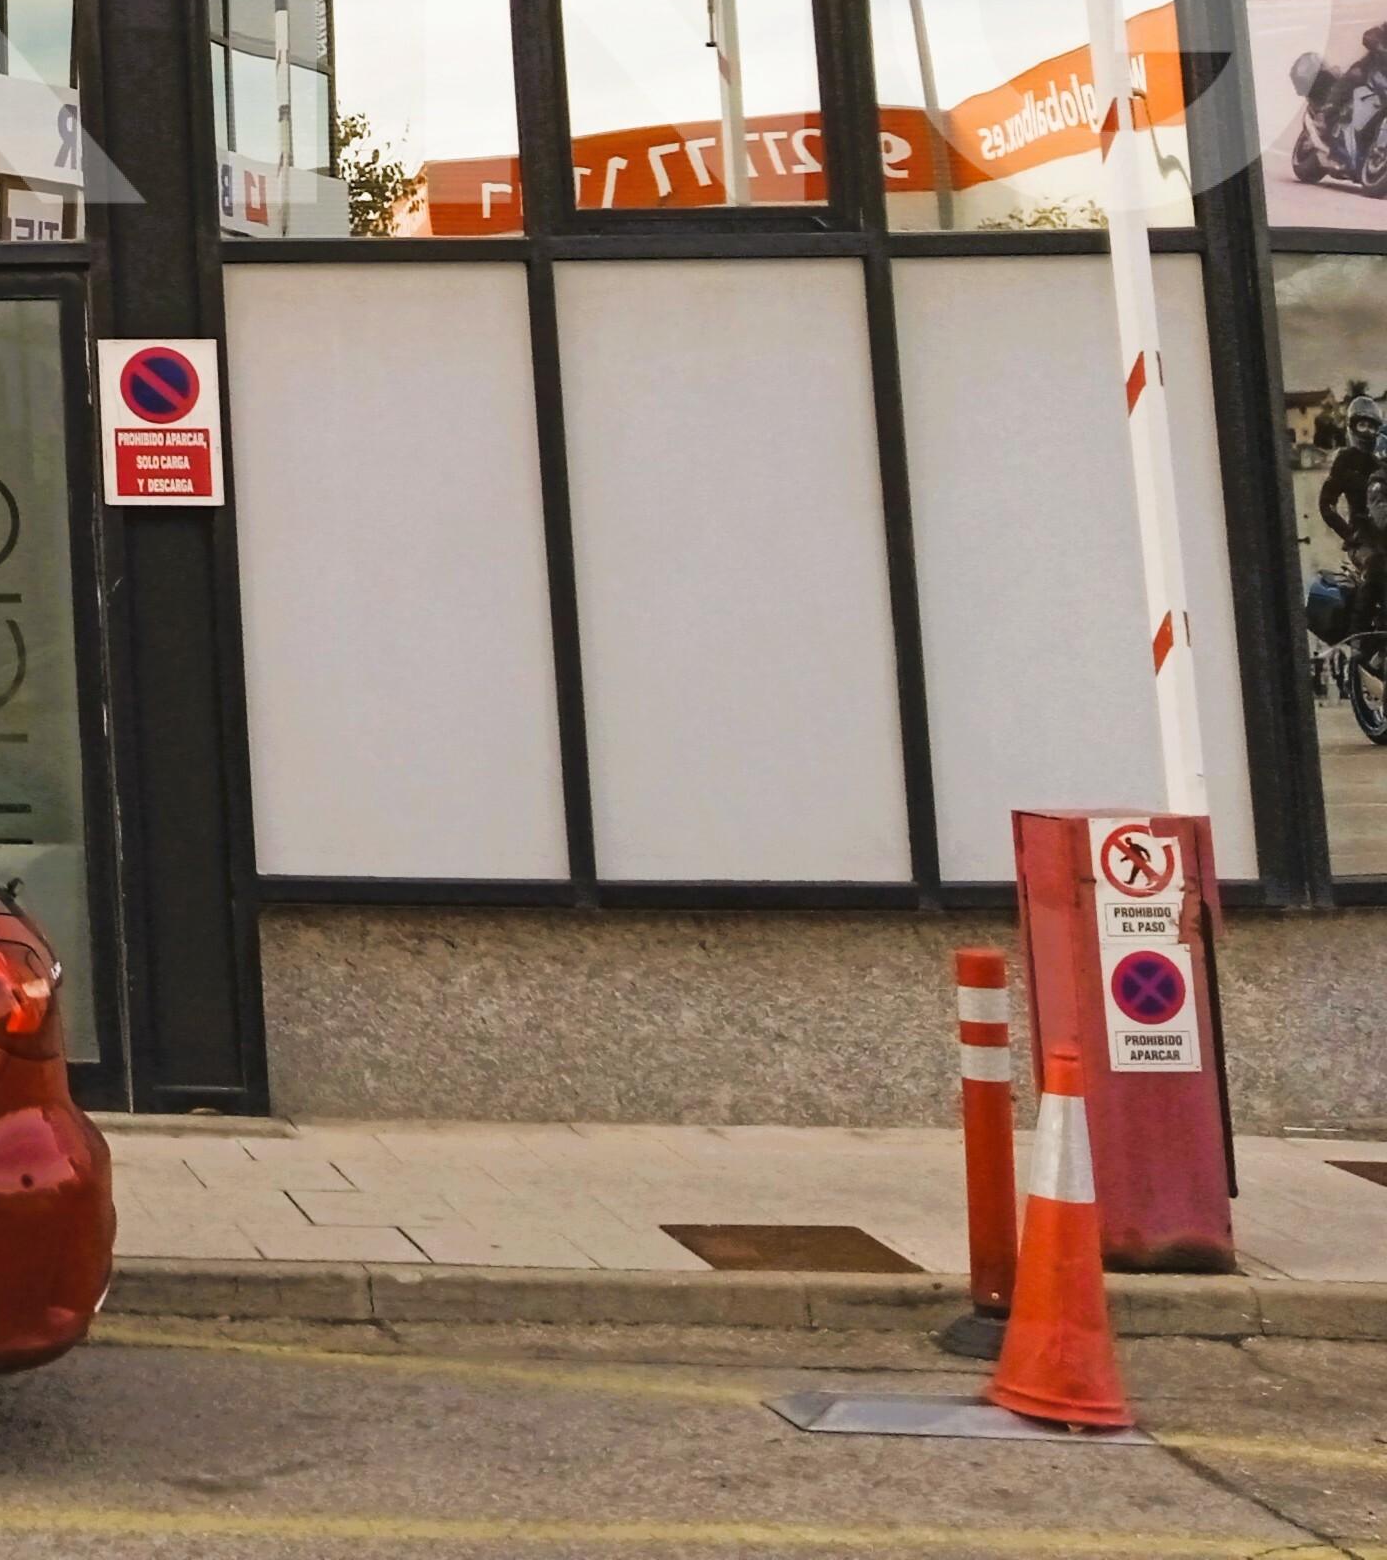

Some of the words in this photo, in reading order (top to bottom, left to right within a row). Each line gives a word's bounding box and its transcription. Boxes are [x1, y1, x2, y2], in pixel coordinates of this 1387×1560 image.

[117, 432, 164, 446] PROHIBIDO
[165, 432, 208, 449] APARCAR,
[136, 455, 159, 469] SOLO
[160, 455, 190, 469] CARGA
[137, 478, 145, 493] Y
[147, 478, 194, 493] DESCARGA
[1114, 907, 1171, 918] PROHIBIDO
[1122, 921, 1134, 933] EL
[1138, 921, 1166, 933] PASO
[1125, 1035, 1183, 1046] PROHIBIDO
[1130, 1050, 1181, 1061] APARCAR
